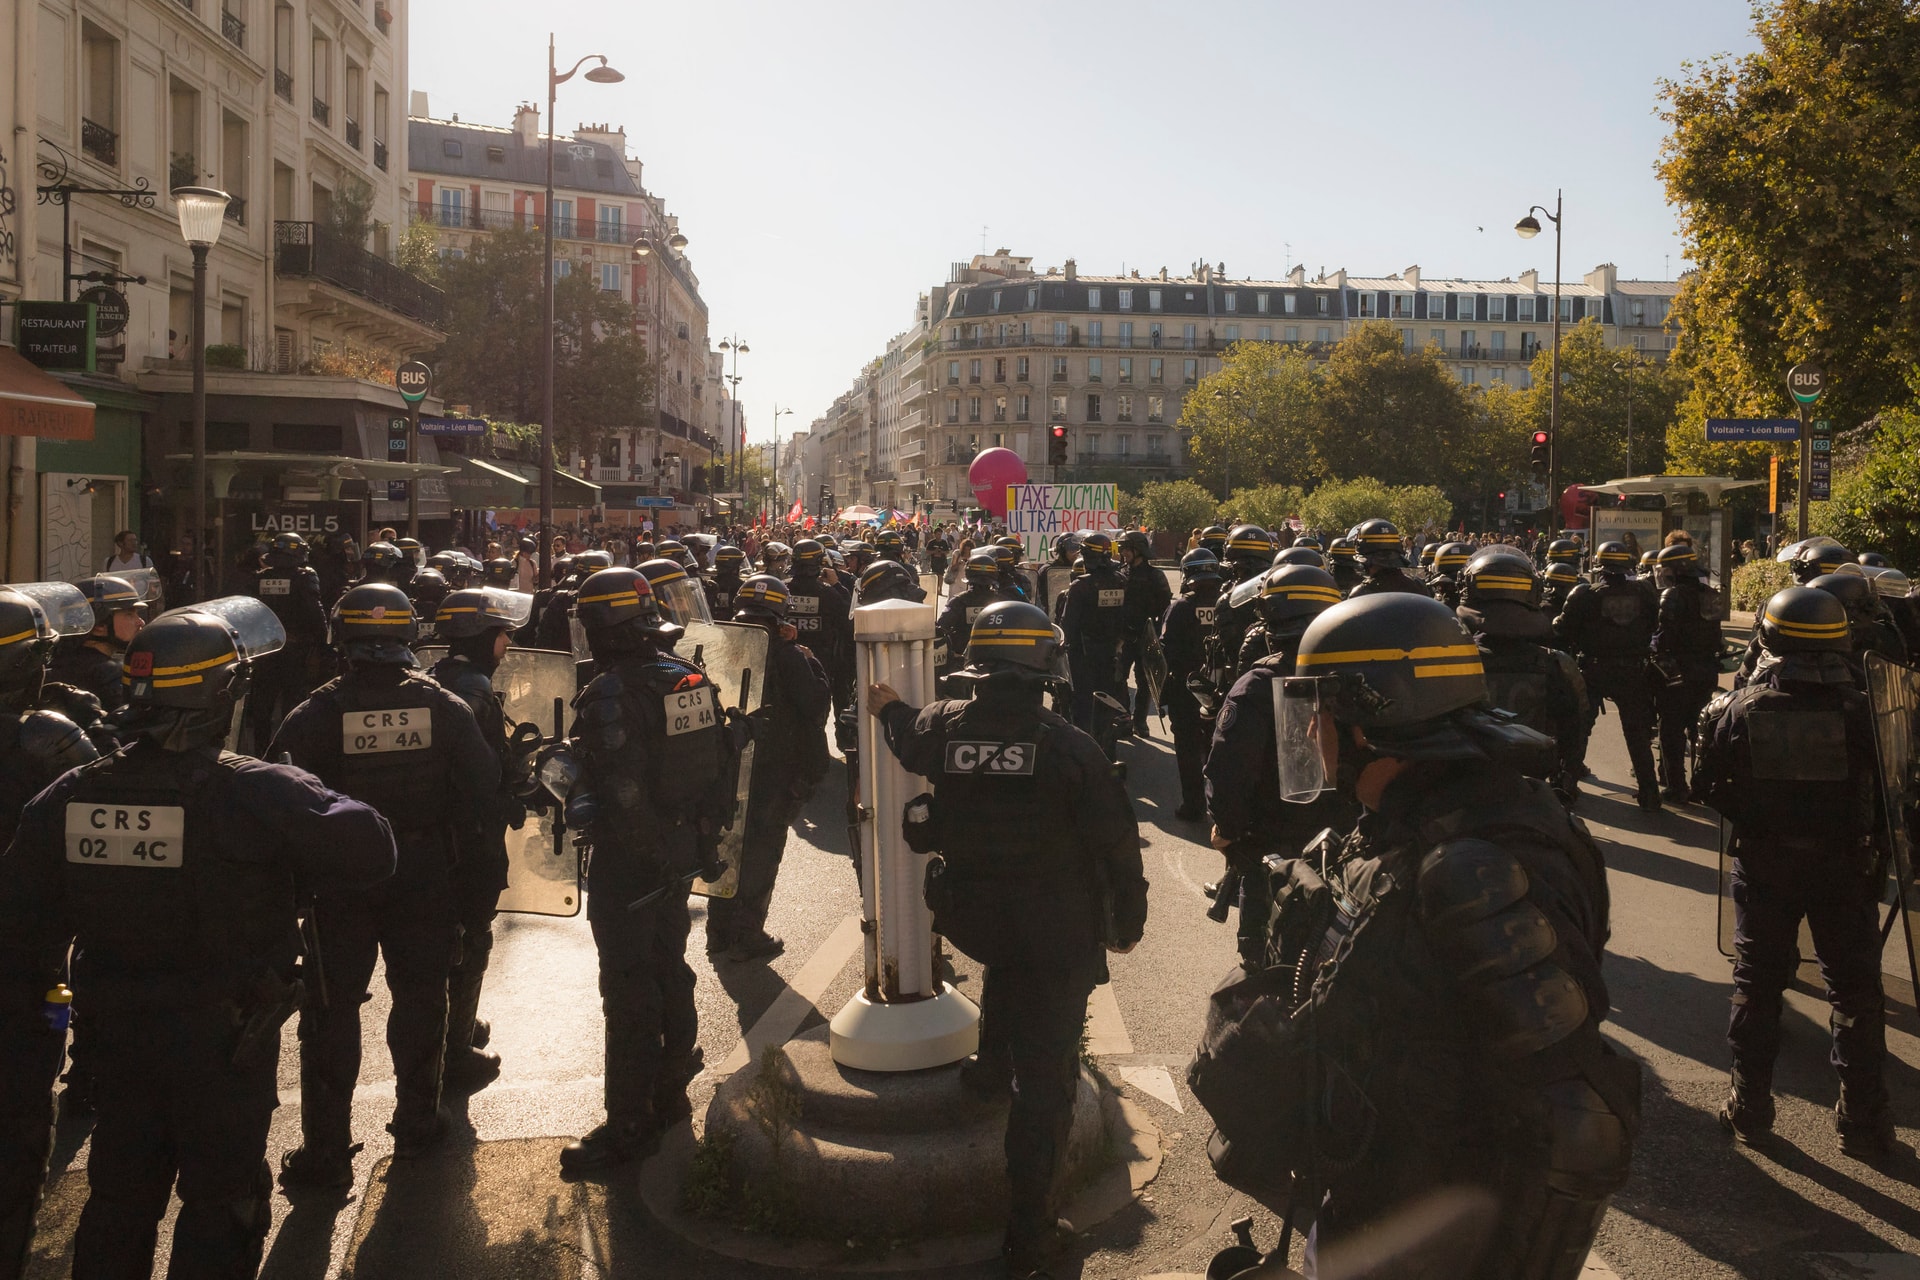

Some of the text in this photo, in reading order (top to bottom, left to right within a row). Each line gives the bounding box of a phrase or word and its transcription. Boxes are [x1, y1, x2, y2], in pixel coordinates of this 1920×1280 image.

[21, 319, 86, 329] RESTAURANT
[29, 344, 78, 353] TRAITEUR
[401, 372, 426, 385] BUS
[1794, 373, 1820, 386] BUS
[392, 420, 404, 429] 61
[420, 423, 445, 431] Voltaire
[451, 423, 466, 431] Léon
[467, 423, 484, 431] Blum
[1712, 426, 1745, 434] Voltaire
[1751, 426, 1772, 434] Léon
[1774, 426, 1795, 434] Blum
[1816, 420, 1828, 430] 61
[391, 440, 404, 449] 69
[1815, 441, 1828, 450] 69
[1007, 485, 1052, 510] TAXE
[1053, 485, 1115, 511] ZUCMAN
[252, 513, 339, 533] LABEL 5
[989, 614, 1004, 625] 36
[131, 657, 148, 670] 02
[677, 692, 702, 709] CRS
[363, 712, 409, 728] CRS
[675, 709, 713, 731] 02 4A
[355, 731, 422, 750] 02 4A
[954, 744, 1024, 771] CRS
[90, 808, 152, 831] CRS
[79, 838, 168, 861] 02 4C
